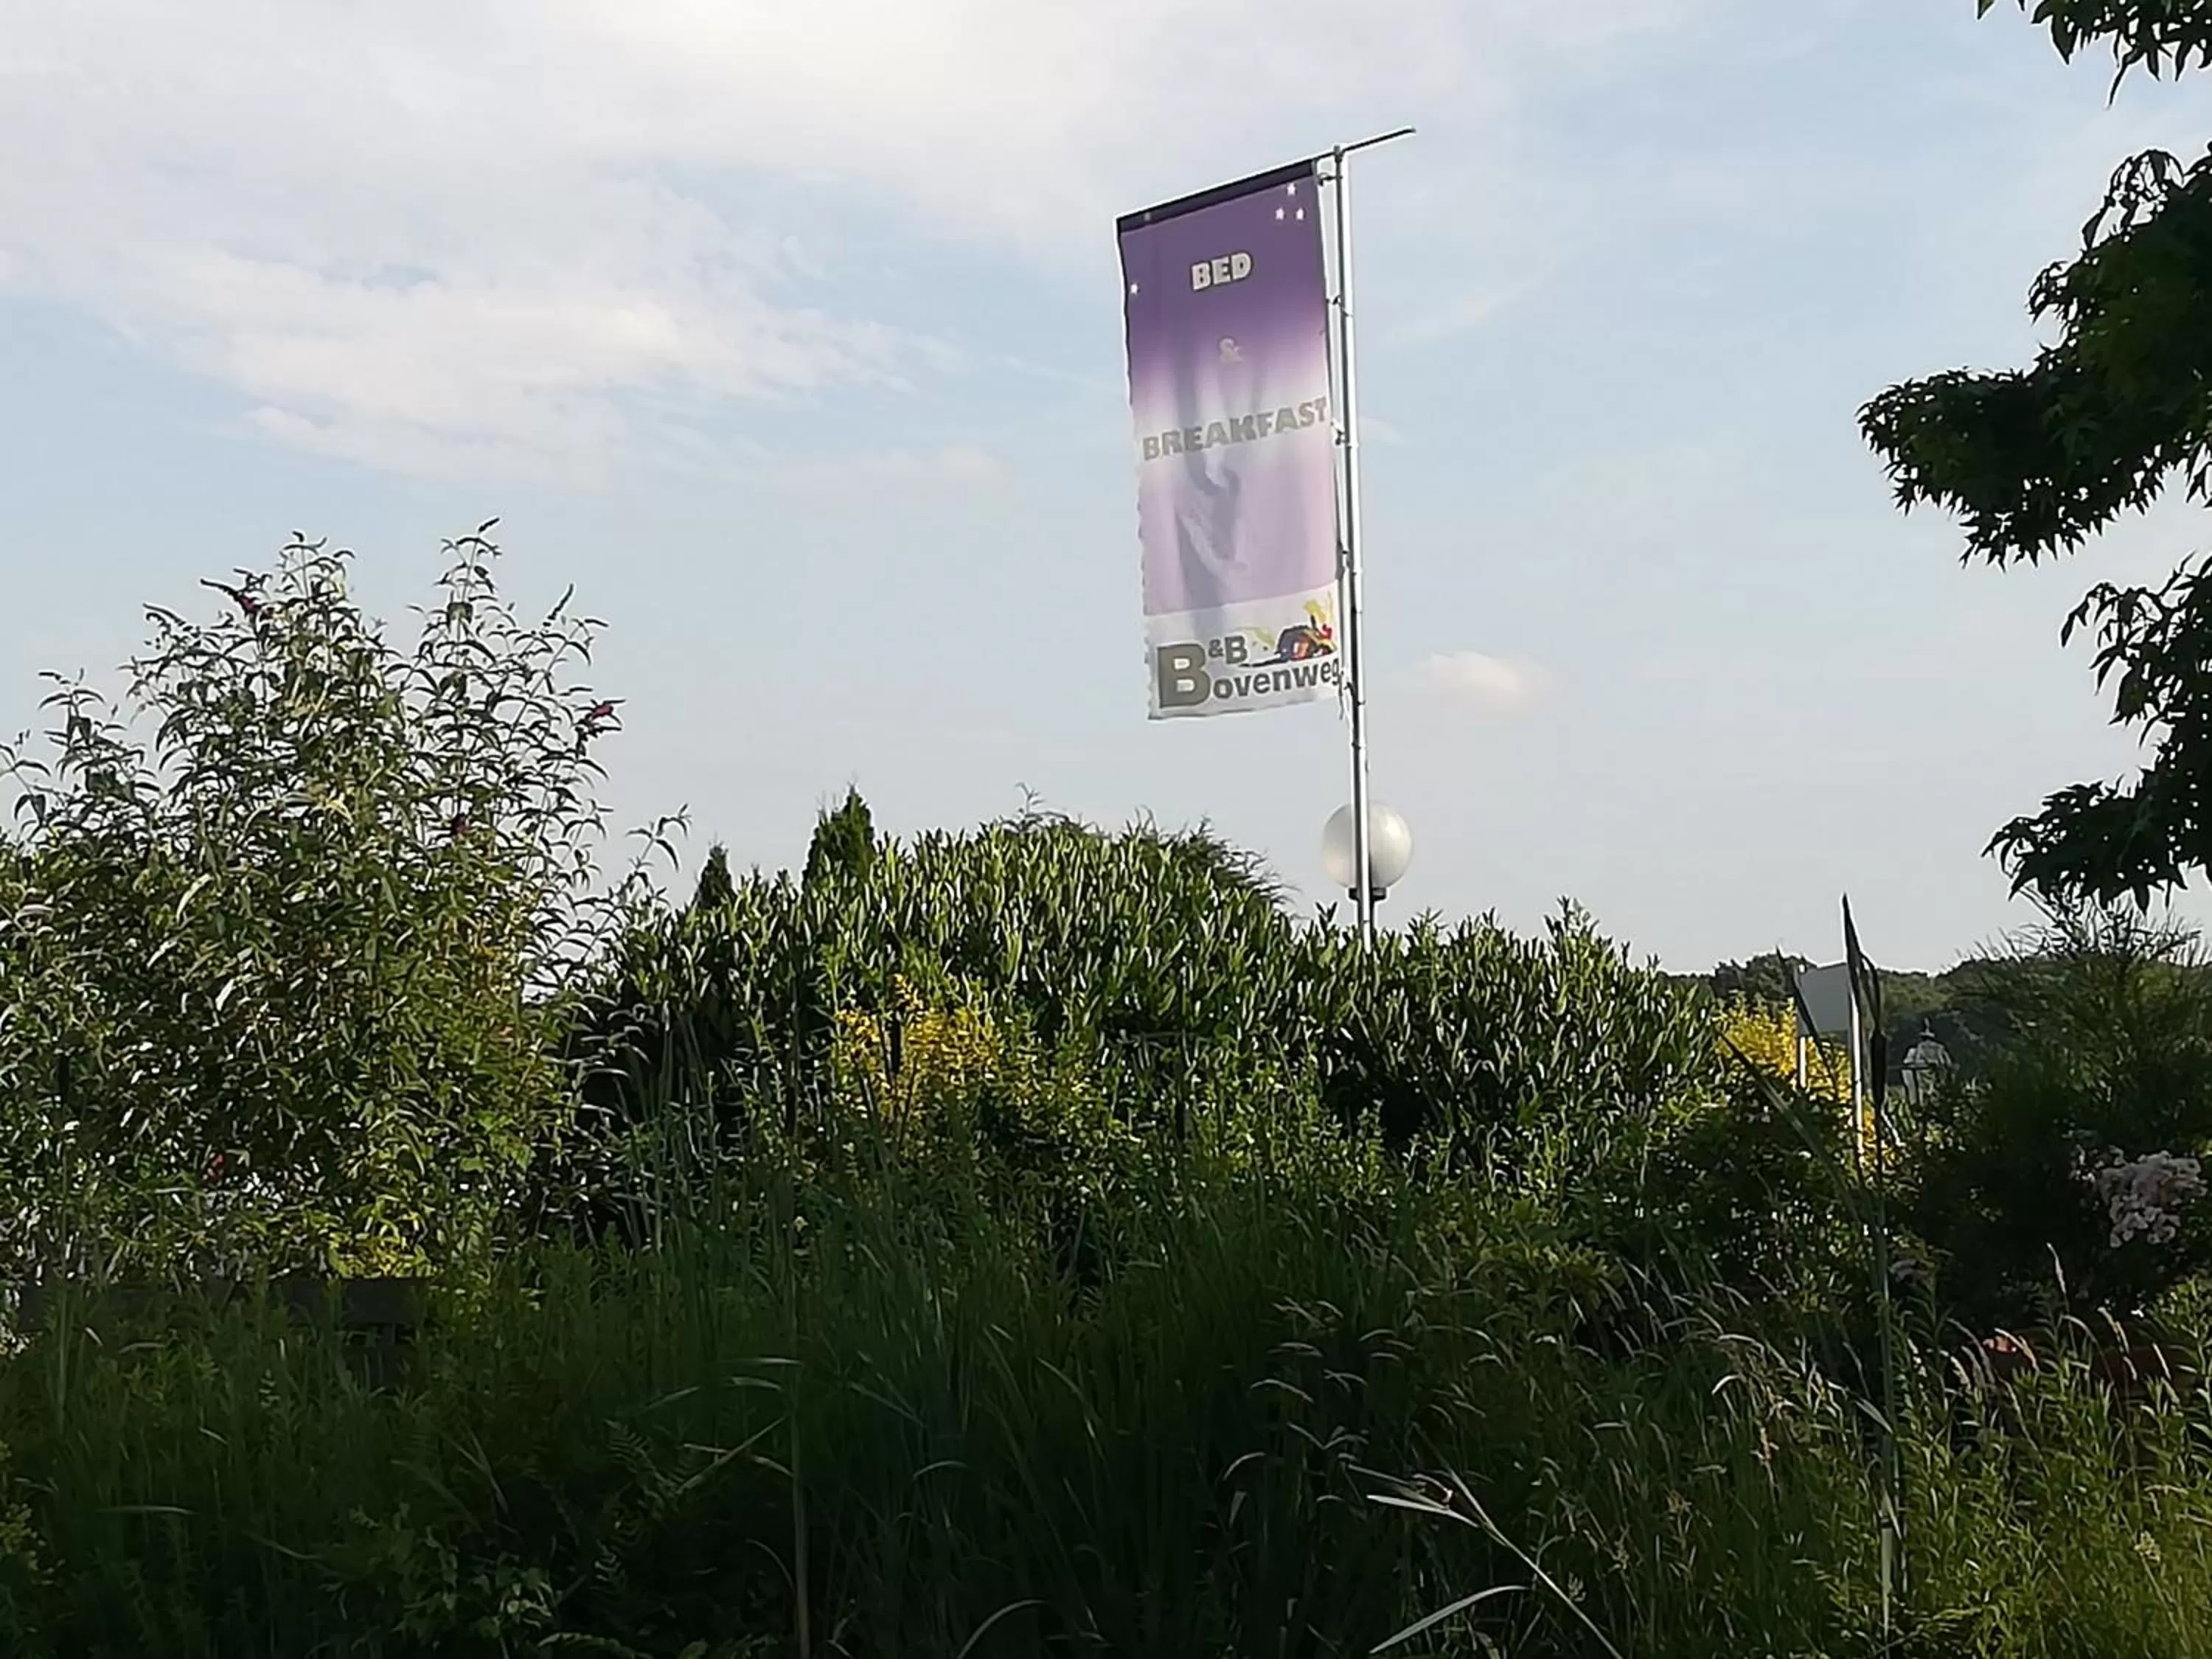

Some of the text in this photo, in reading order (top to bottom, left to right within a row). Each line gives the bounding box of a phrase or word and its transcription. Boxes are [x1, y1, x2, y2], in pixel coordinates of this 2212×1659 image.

[1191, 251, 1253, 291] BED
[1218, 336, 1242, 364] &
[1142, 397, 1328, 462] BREAKFAST
